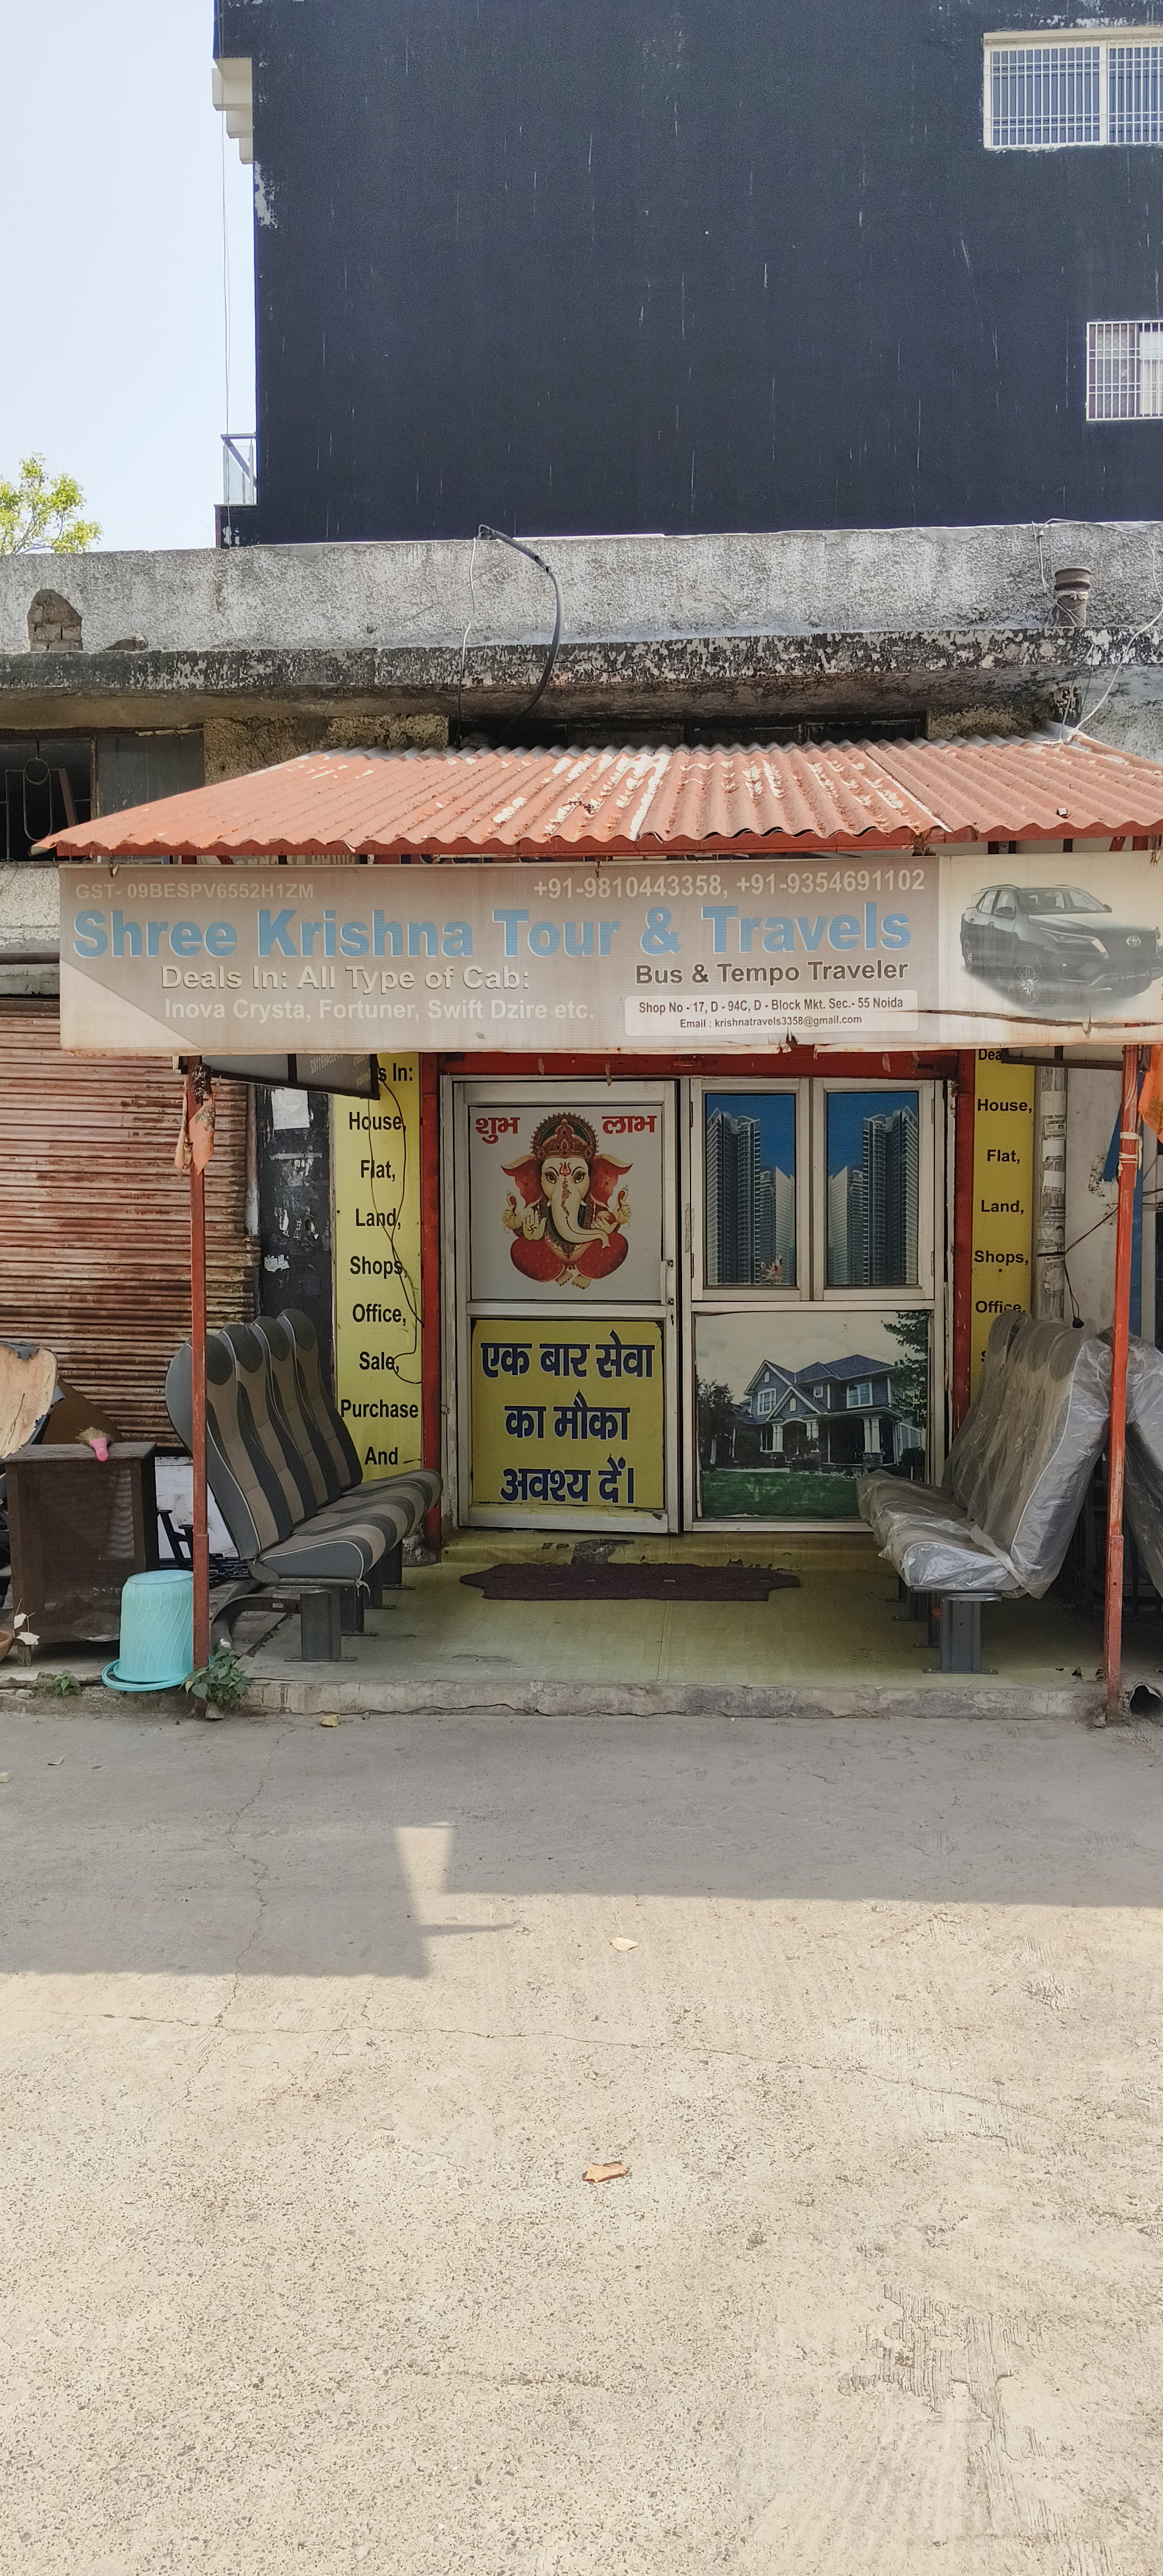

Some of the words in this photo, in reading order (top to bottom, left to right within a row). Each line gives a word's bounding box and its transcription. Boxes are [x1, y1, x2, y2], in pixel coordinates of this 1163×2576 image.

[76, 884, 121, 899] GST-
[127, 883, 314, 898] 09BESPV6552H1ZM
[534, 874, 728, 899] +91-9810443358,
[736, 869, 925, 895] +91-9354691102
[73, 909, 237, 958] Shree
[257, 909, 474, 958] Krishna
[492, 908, 621, 958] Tour
[640, 907, 681, 955] &
[701, 902, 911, 954] Travels
[162, 966, 243, 989] Deals
[253, 966, 287, 989] In:
[297, 966, 335, 989] All
[346, 966, 415, 995] Type
[425, 966, 454, 989] of
[464, 966, 530, 989] Cab:
[636, 964, 683, 985] Bus
[691, 964, 710, 984] &
[717, 962, 800, 986] Tempo
[808, 959, 909, 982] Traveler
[166, 999, 225, 1019] Inova
[233, 999, 311, 1024] Crysta,
[320, 999, 419, 1022] Fortuner,
[427, 999, 483, 1019] Swift
[491, 998, 547, 1019] Dzire
[554, 1000, 594, 1019] etc.
[639, 1002, 665, 1016] Shop
[669, 1002, 683, 1013] No
[693, 1001, 708, 1014] 17,
[711, 1001, 718, 1012] D
[728, 1001, 751, 1013] 94C,
[754, 1000, 762, 1011] D
[772, 999, 801, 1011] Block
[805, 998, 826, 1010] Mkt.
[858, 997, 870, 1008] 55
[873, 997, 904, 1008] Noida
[680, 1019, 706, 1028] Email
[715, 1014, 862, 1027] krishnatravels3358@gmail.com
[977, 1098, 1032, 1114] House,
[349, 1111, 406, 1131] House,
[475, 1117, 520, 1144] शुभ
[602, 1115, 657, 1134] लाभ
[987, 1149, 1020, 1164] Flat,
[361, 1159, 396, 1182] Flat,
[356, 1208, 401, 1230] Land,
[981, 1200, 1024, 1215] Land,
[350, 1256, 408, 1279] Shops,
[974, 1250, 1029, 1266] Shops,
[352, 1303, 406, 1326] Office,
[359, 1351, 400, 1374] Sale,
[481, 1343, 532, 1379] एक
[540, 1343, 590, 1377] बार
[595, 1329, 655, 1378] सेवा
[341, 1399, 419, 1418] Purchase
[504, 1406, 547, 1439] का
[553, 1389, 630, 1441] मौका
[365, 1446, 399, 1465] And
[500, 1467, 591, 1502] अवश्य
